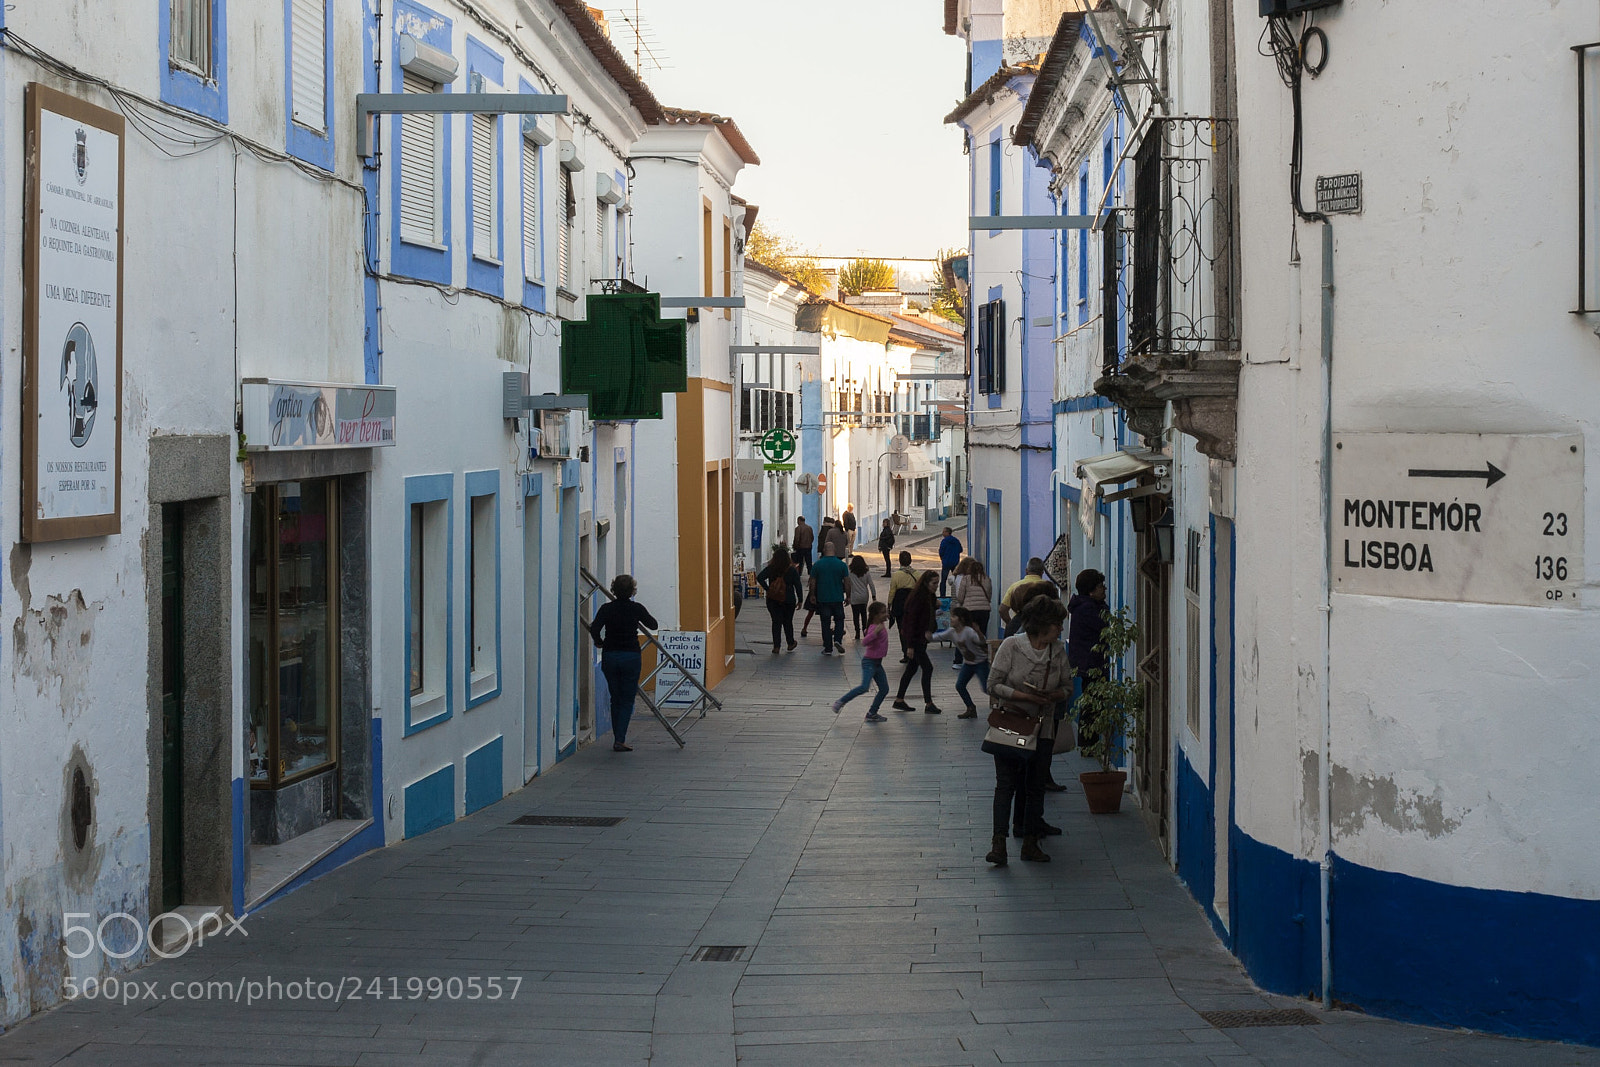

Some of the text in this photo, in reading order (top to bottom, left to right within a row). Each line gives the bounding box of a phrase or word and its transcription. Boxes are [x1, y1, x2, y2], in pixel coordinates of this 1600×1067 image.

[1323, 175, 1358, 189] PROIBIDO
[87, 194, 92, 203] DE
[50, 217, 110, 242] NA COZINHA ALENTEJANA
[43, 235, 114, 262] O REQUINTE DA GASTRONOMIA
[46, 283, 111, 308] UMA MESA DIFERENTE
[339, 390, 382, 443] ver bem
[47, 461, 107, 473] OS NOSSOS RESTAURANTES
[58, 480, 96, 491] ESPERAM POR SI
[1344, 497, 1568, 536] MONTEMÓR 23
[1344, 539, 1568, 581] LISBOA 136
